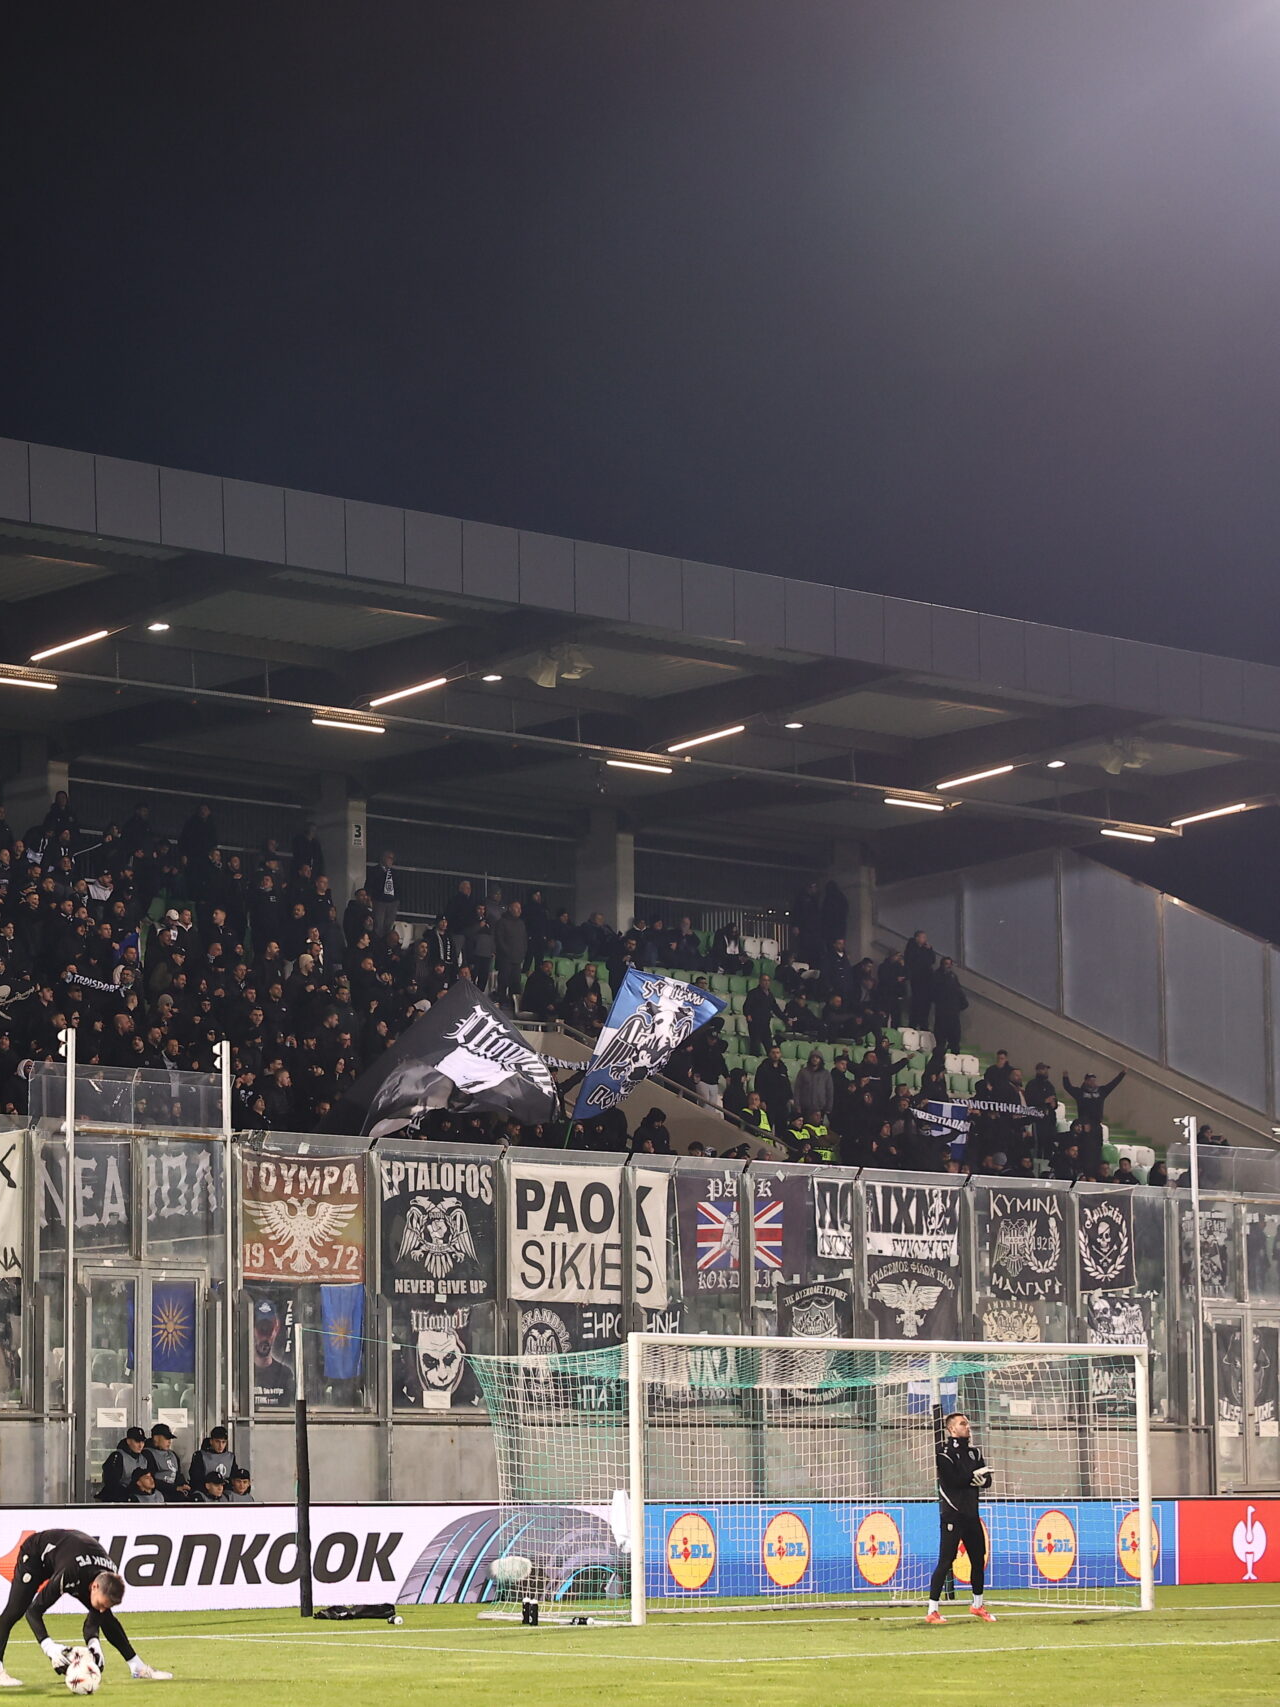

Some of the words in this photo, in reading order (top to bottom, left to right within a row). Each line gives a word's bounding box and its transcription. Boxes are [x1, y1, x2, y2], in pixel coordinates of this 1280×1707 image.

[354, 824, 362, 838] 3
[381, 1160, 493, 1206] EPTALOFOS
[705, 1178, 773, 1201] PAK
[515, 1178, 652, 1238] PAOK
[245, 1243, 265, 1268] 19
[332, 1244, 359, 1271] 72
[520, 1239, 654, 1295] SIKIES
[394, 1279, 435, 1294] NEVER
[438, 1279, 467, 1294] GIVE
[470, 1279, 488, 1294] UP
[697, 1269, 771, 1291] KORDLI
[937, 1271, 955, 1290] ΠΑΟ
[582, 1310, 681, 1340] ΞΗΡΟΗΝΗ
[670, 1536, 712, 1562] LIDL
[766, 1535, 806, 1560] LIDL
[858, 1534, 898, 1558] LIDL
[1036, 1532, 1073, 1555] LIDL
[1121, 1531, 1156, 1554] LI
